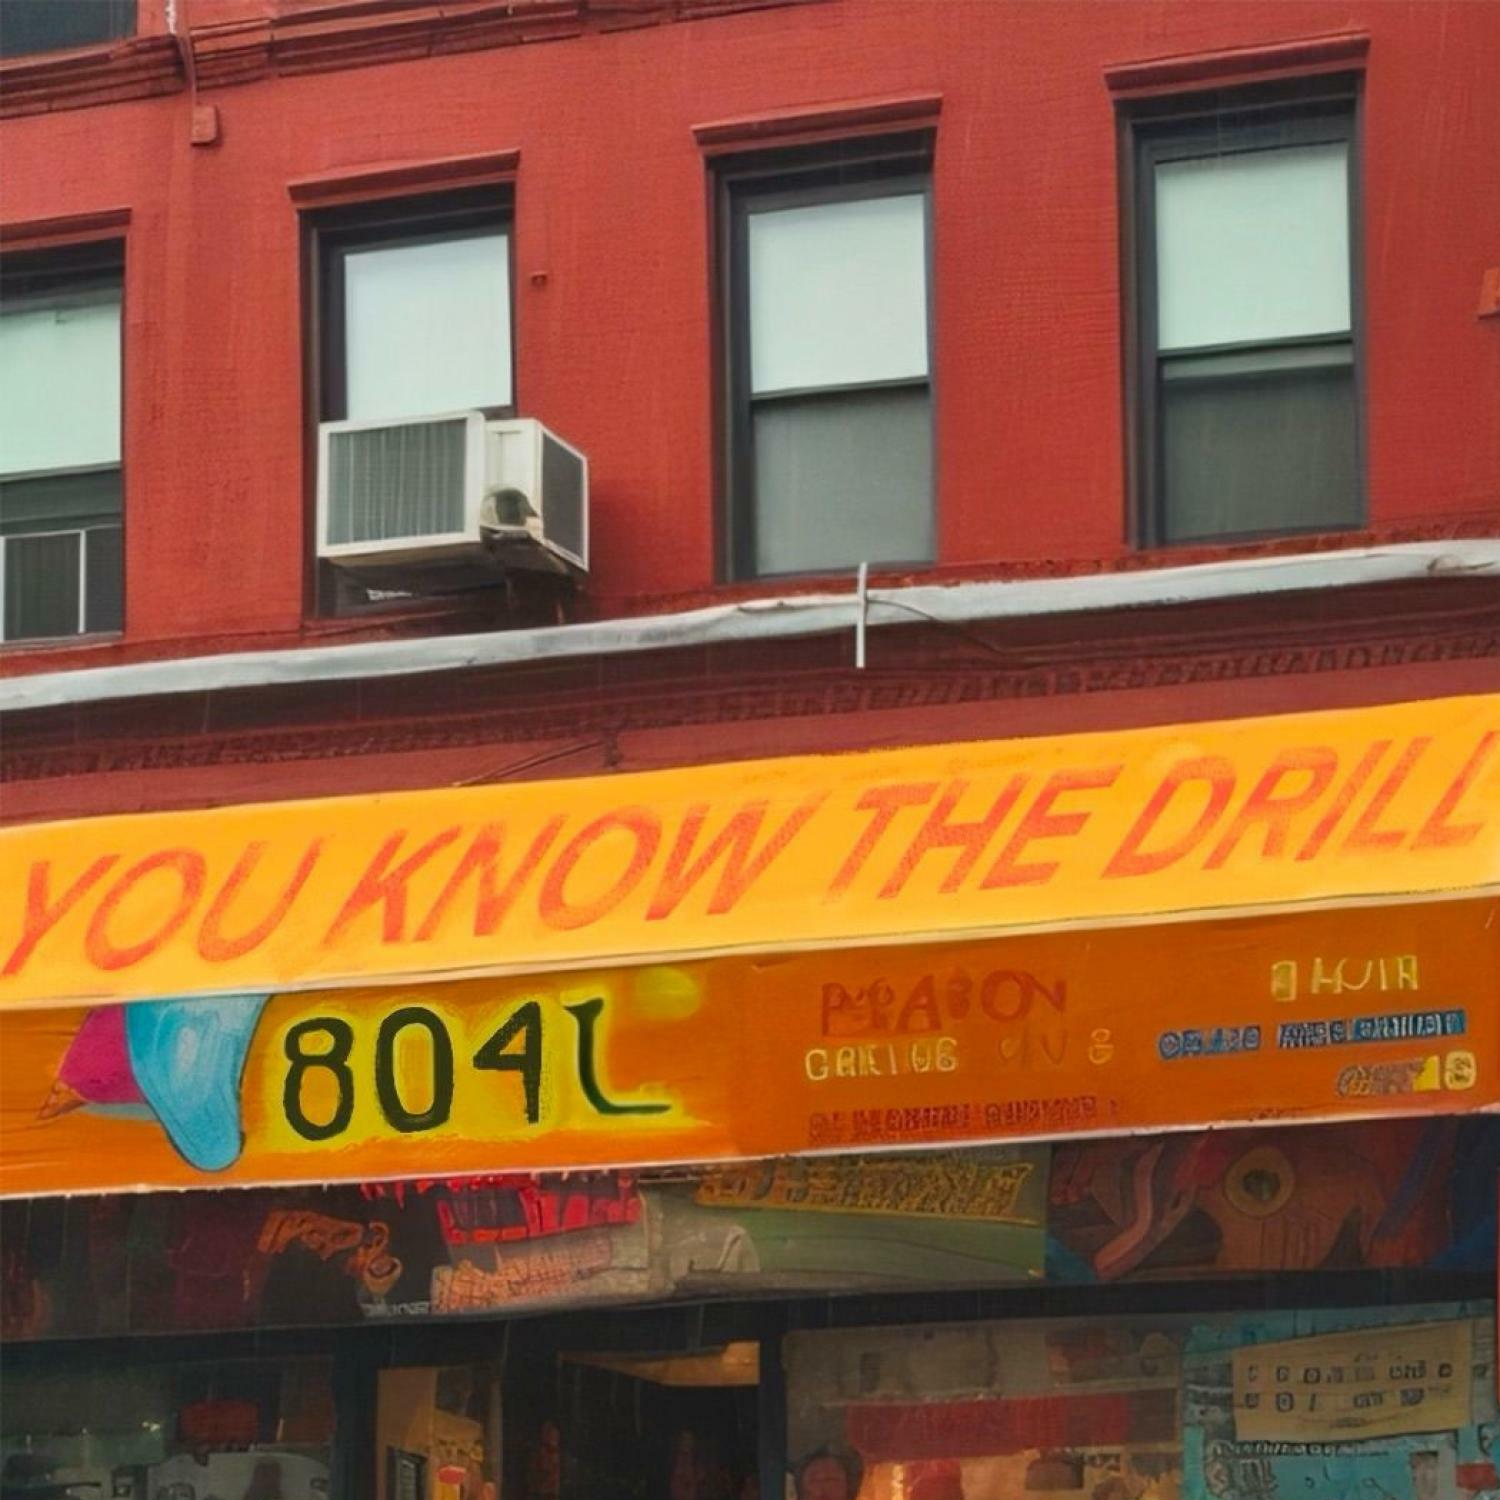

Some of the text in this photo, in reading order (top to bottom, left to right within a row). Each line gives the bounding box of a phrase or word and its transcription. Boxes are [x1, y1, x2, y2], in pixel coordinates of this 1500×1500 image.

[1, 835, 324, 977] YOU
[326, 795, 823, 944] KNOW
[823, 762, 1124, 904] THE
